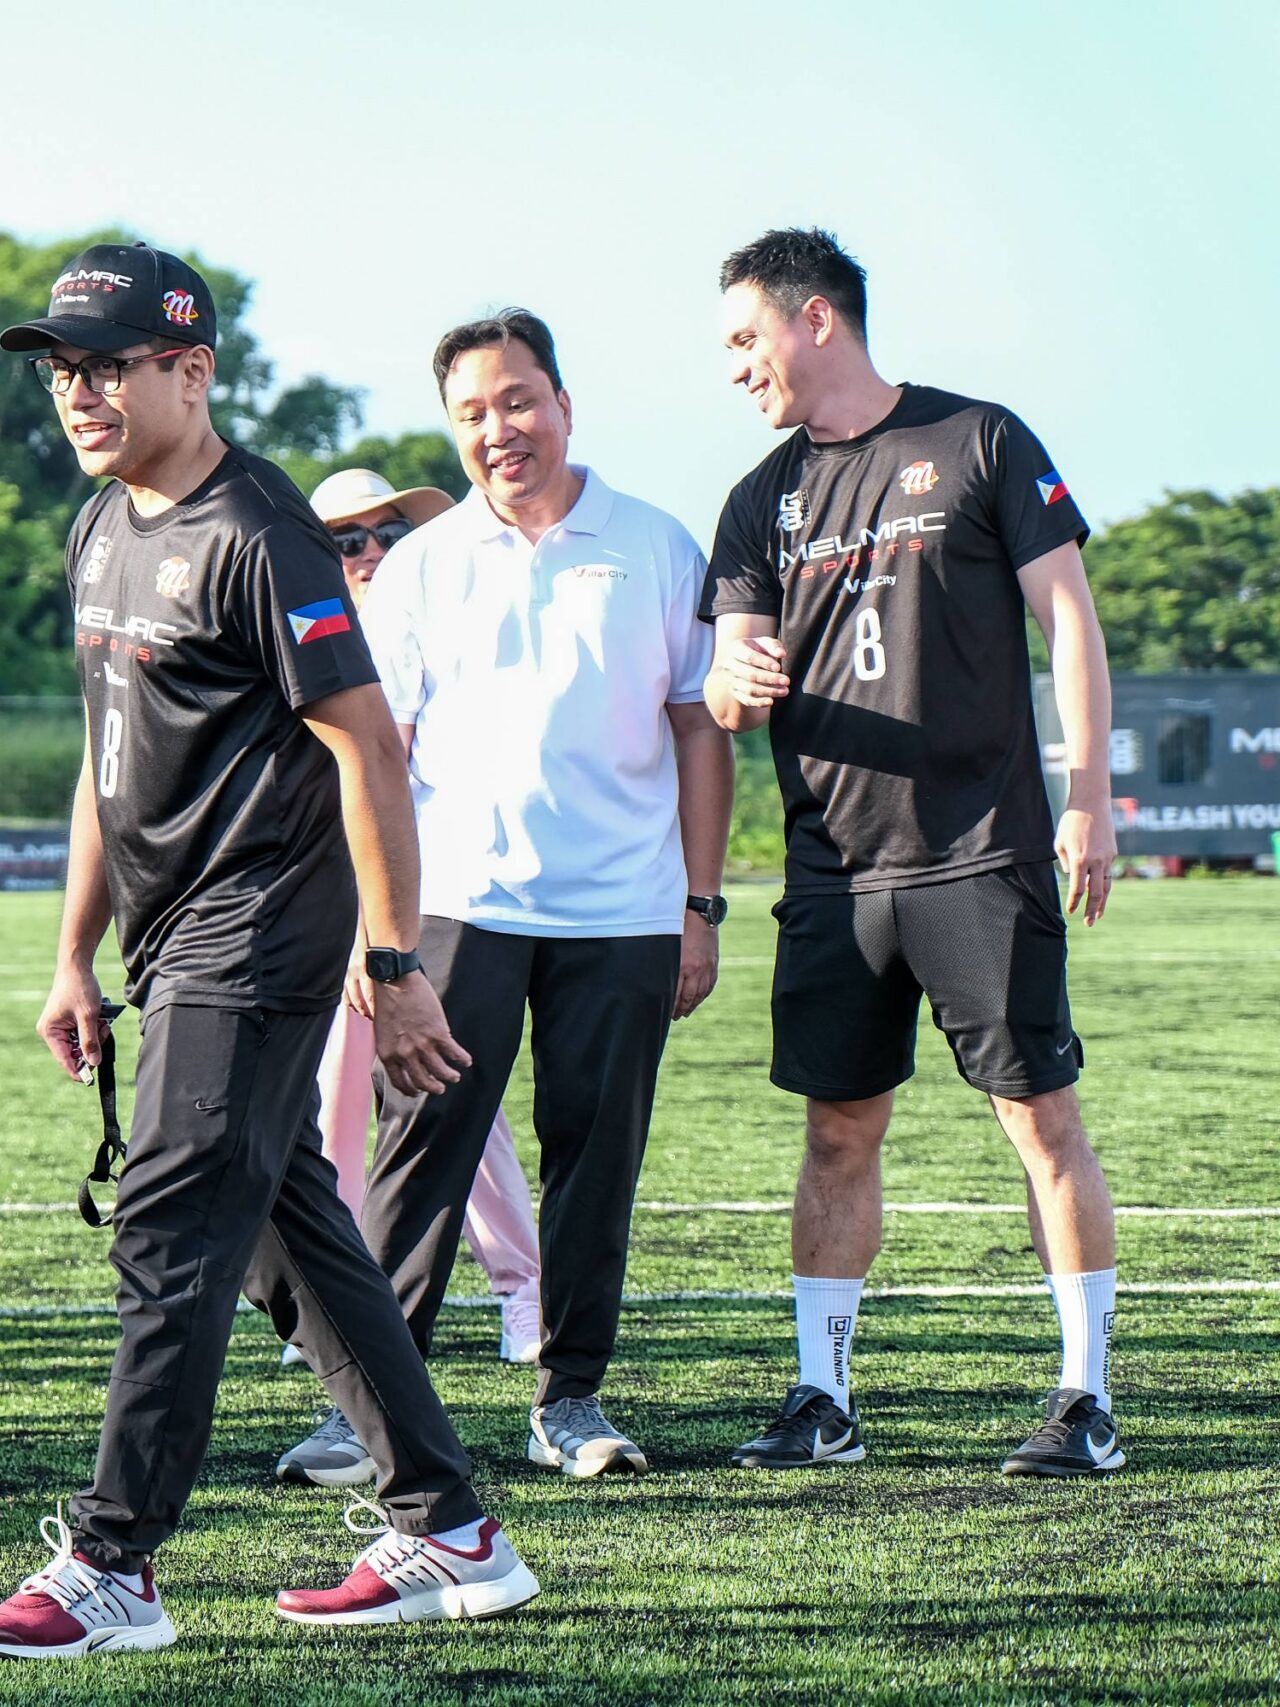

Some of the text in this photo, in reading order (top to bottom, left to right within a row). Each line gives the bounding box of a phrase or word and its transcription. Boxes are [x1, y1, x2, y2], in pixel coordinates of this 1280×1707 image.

[51, 269, 133, 293] LMAC
[779, 511, 946, 568] MELMAC
[800, 538, 924, 580] SPORTS
[854, 607, 887, 681] 8
[99, 708, 123, 799] 8
[833, 1335, 845, 1387] TRAINING
